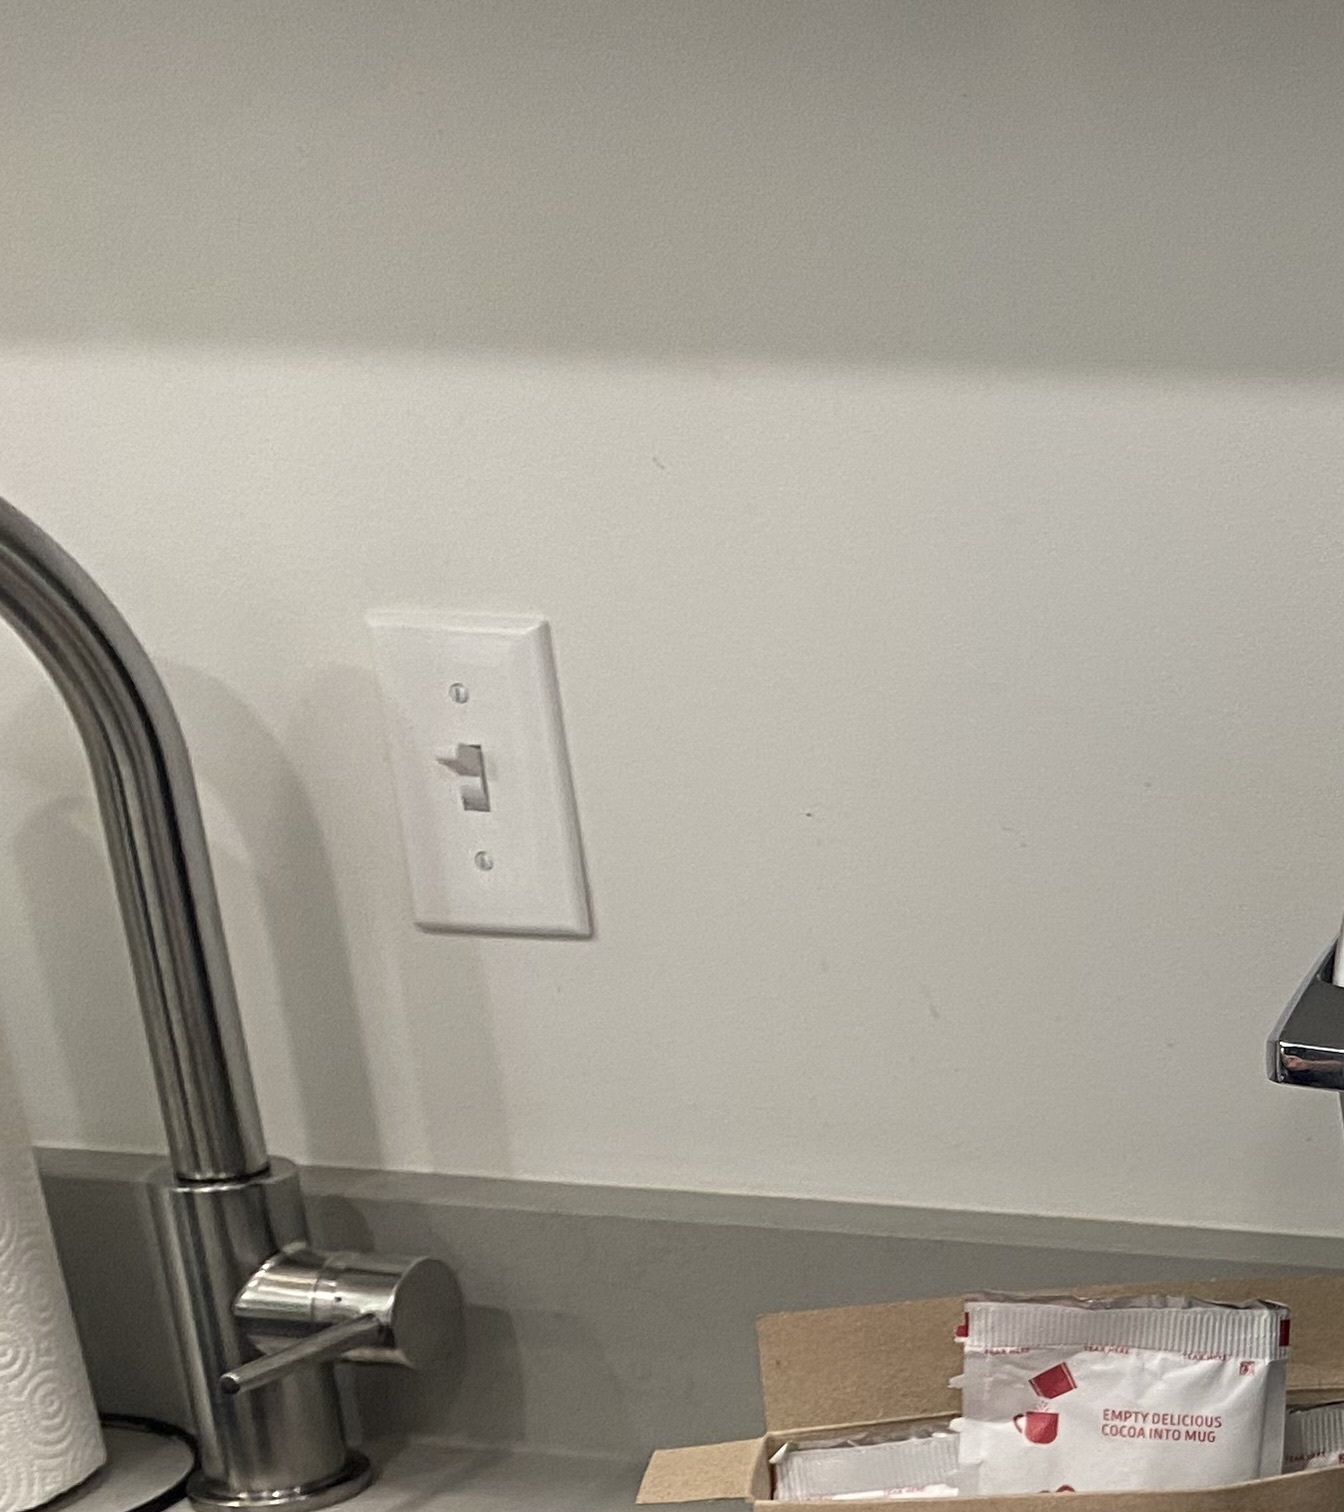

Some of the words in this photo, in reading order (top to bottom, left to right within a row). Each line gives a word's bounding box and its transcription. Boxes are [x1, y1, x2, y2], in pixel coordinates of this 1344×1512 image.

[1103, 1409, 1149, 1424] EMPTY
[1151, 1413, 1222, 1428] DELICIOUS
[1101, 1425, 1146, 1439] COCOA
[1149, 1428, 1180, 1441] INTO
[1184, 1429, 1217, 1443] MUG
